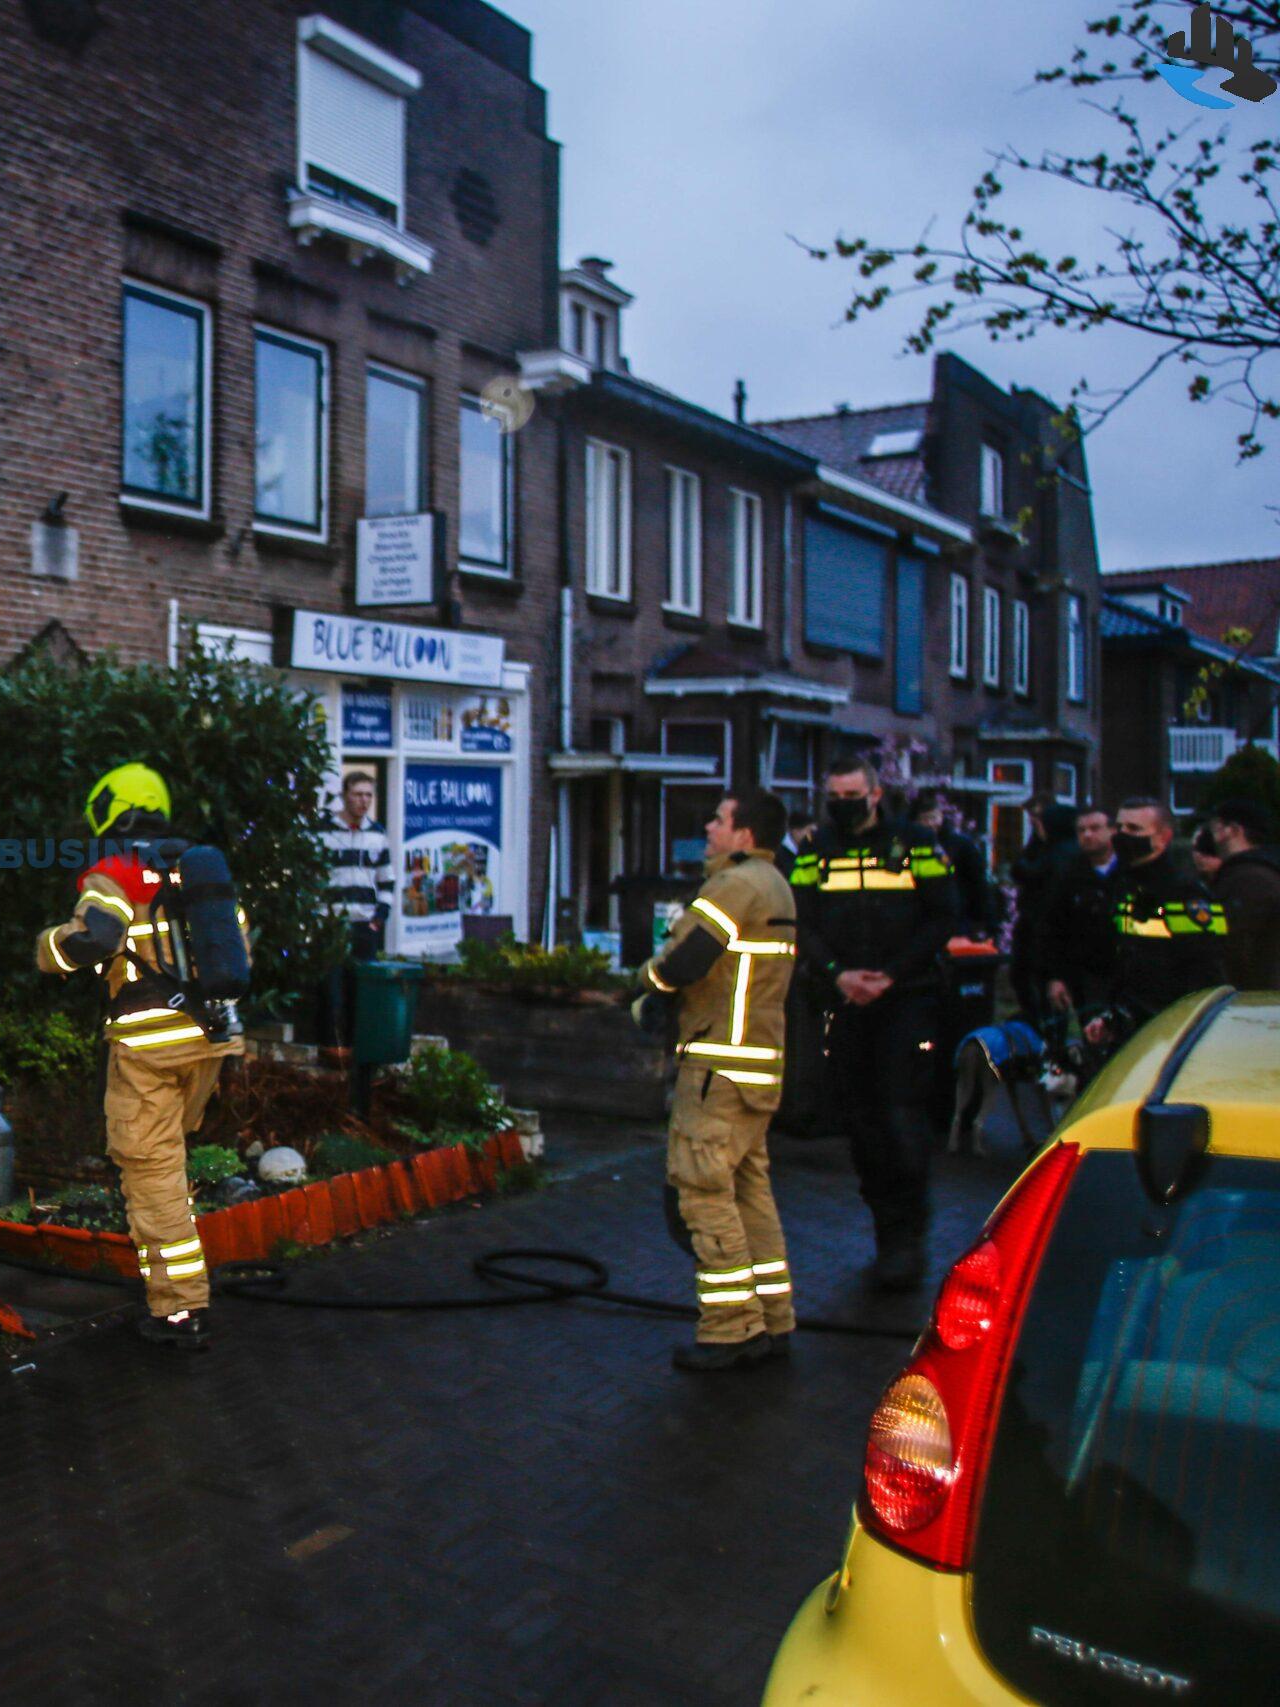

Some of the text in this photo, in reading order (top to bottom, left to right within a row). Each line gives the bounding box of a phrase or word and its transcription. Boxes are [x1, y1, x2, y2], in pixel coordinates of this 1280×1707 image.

[314, 618, 451, 671] BLUE BALLOON
[405, 778, 493, 807] BLUE BALLOON
[1031, 1625, 1190, 1692] PEUGEOT
